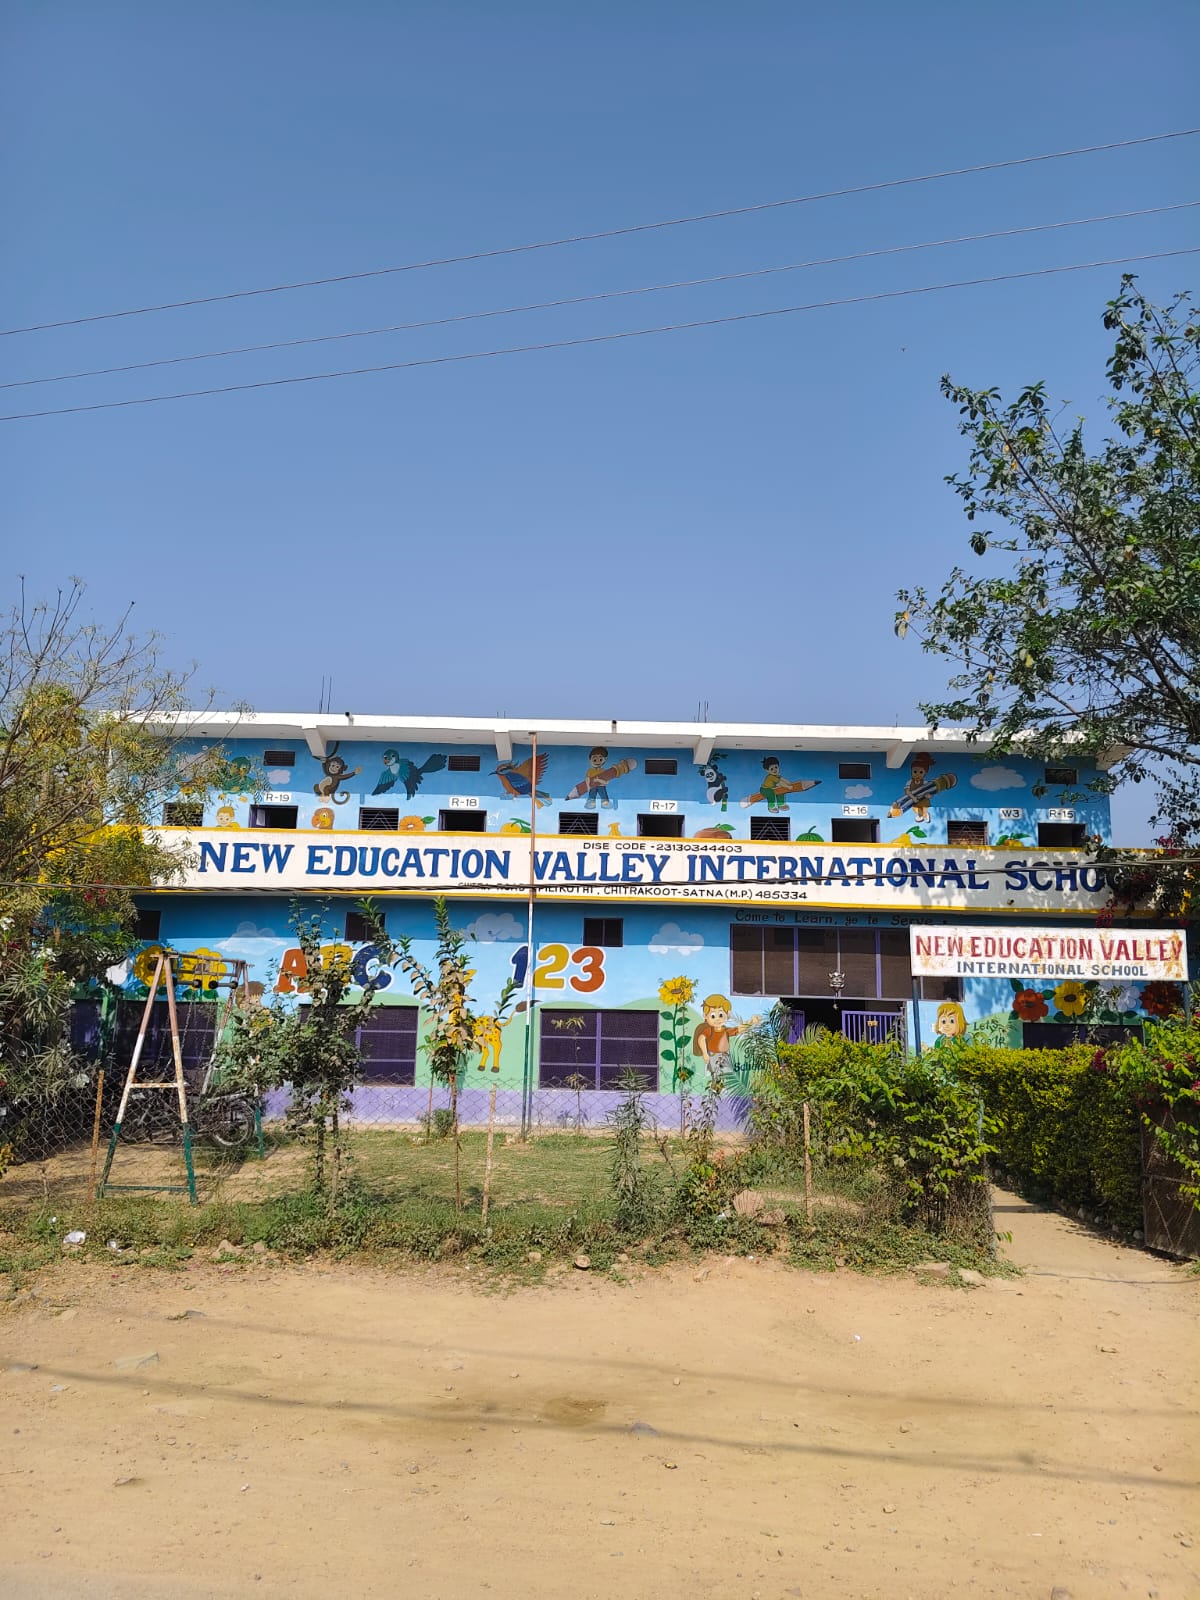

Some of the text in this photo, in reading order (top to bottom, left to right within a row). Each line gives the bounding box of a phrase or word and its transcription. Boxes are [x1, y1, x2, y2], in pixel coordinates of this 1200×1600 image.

[265, 793, 290, 802] R-19
[451, 797, 477, 807] R-18
[652, 801, 676, 811] R-17
[843, 805, 867, 815] R-16
[1001, 809, 1020, 818] W3
[1049, 809, 1074, 819] R-15
[583, 842, 610, 850] DISE
[615, 842, 646, 850] CODE
[198, 841, 1118, 892] NEW EDUCATION VALLEY INTERNATIONAL SCHO
[755, 890, 808, 900] 485334
[735, 909, 769, 922] Come
[915, 935, 1183, 962] NEW EDUCATION VALLEY
[511, 943, 605, 993] 123
[957, 961, 1149, 977] INTERNATIONAL SCHOOL
